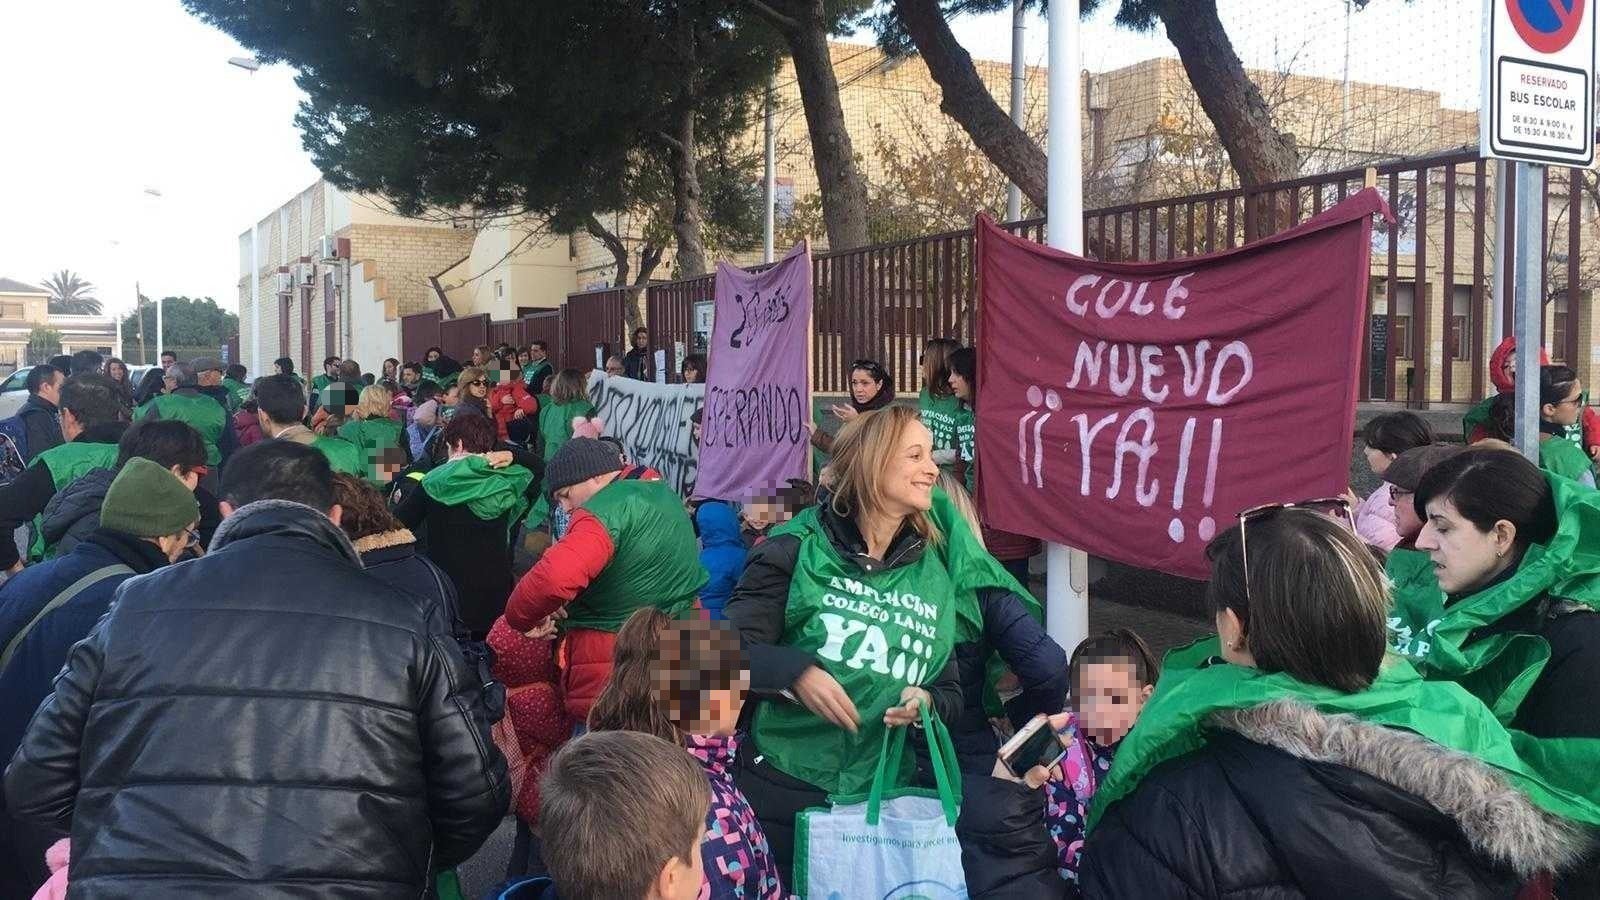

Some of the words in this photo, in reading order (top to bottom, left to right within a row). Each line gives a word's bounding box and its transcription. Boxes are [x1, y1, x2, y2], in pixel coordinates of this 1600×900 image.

[1520, 74, 1568, 90] RESERVADO
[1510, 91, 1530, 104] BUS
[1533, 94, 1576, 111] ESCOLAR
[1513, 126, 1521, 134] DE
[1065, 271, 1196, 320] COLE
[1066, 339, 1254, 406] NUEVO
[704, 383, 803, 448] ESPERANDO
[842, 832, 901, 847] Investigamos
[902, 839, 920, 849] para
